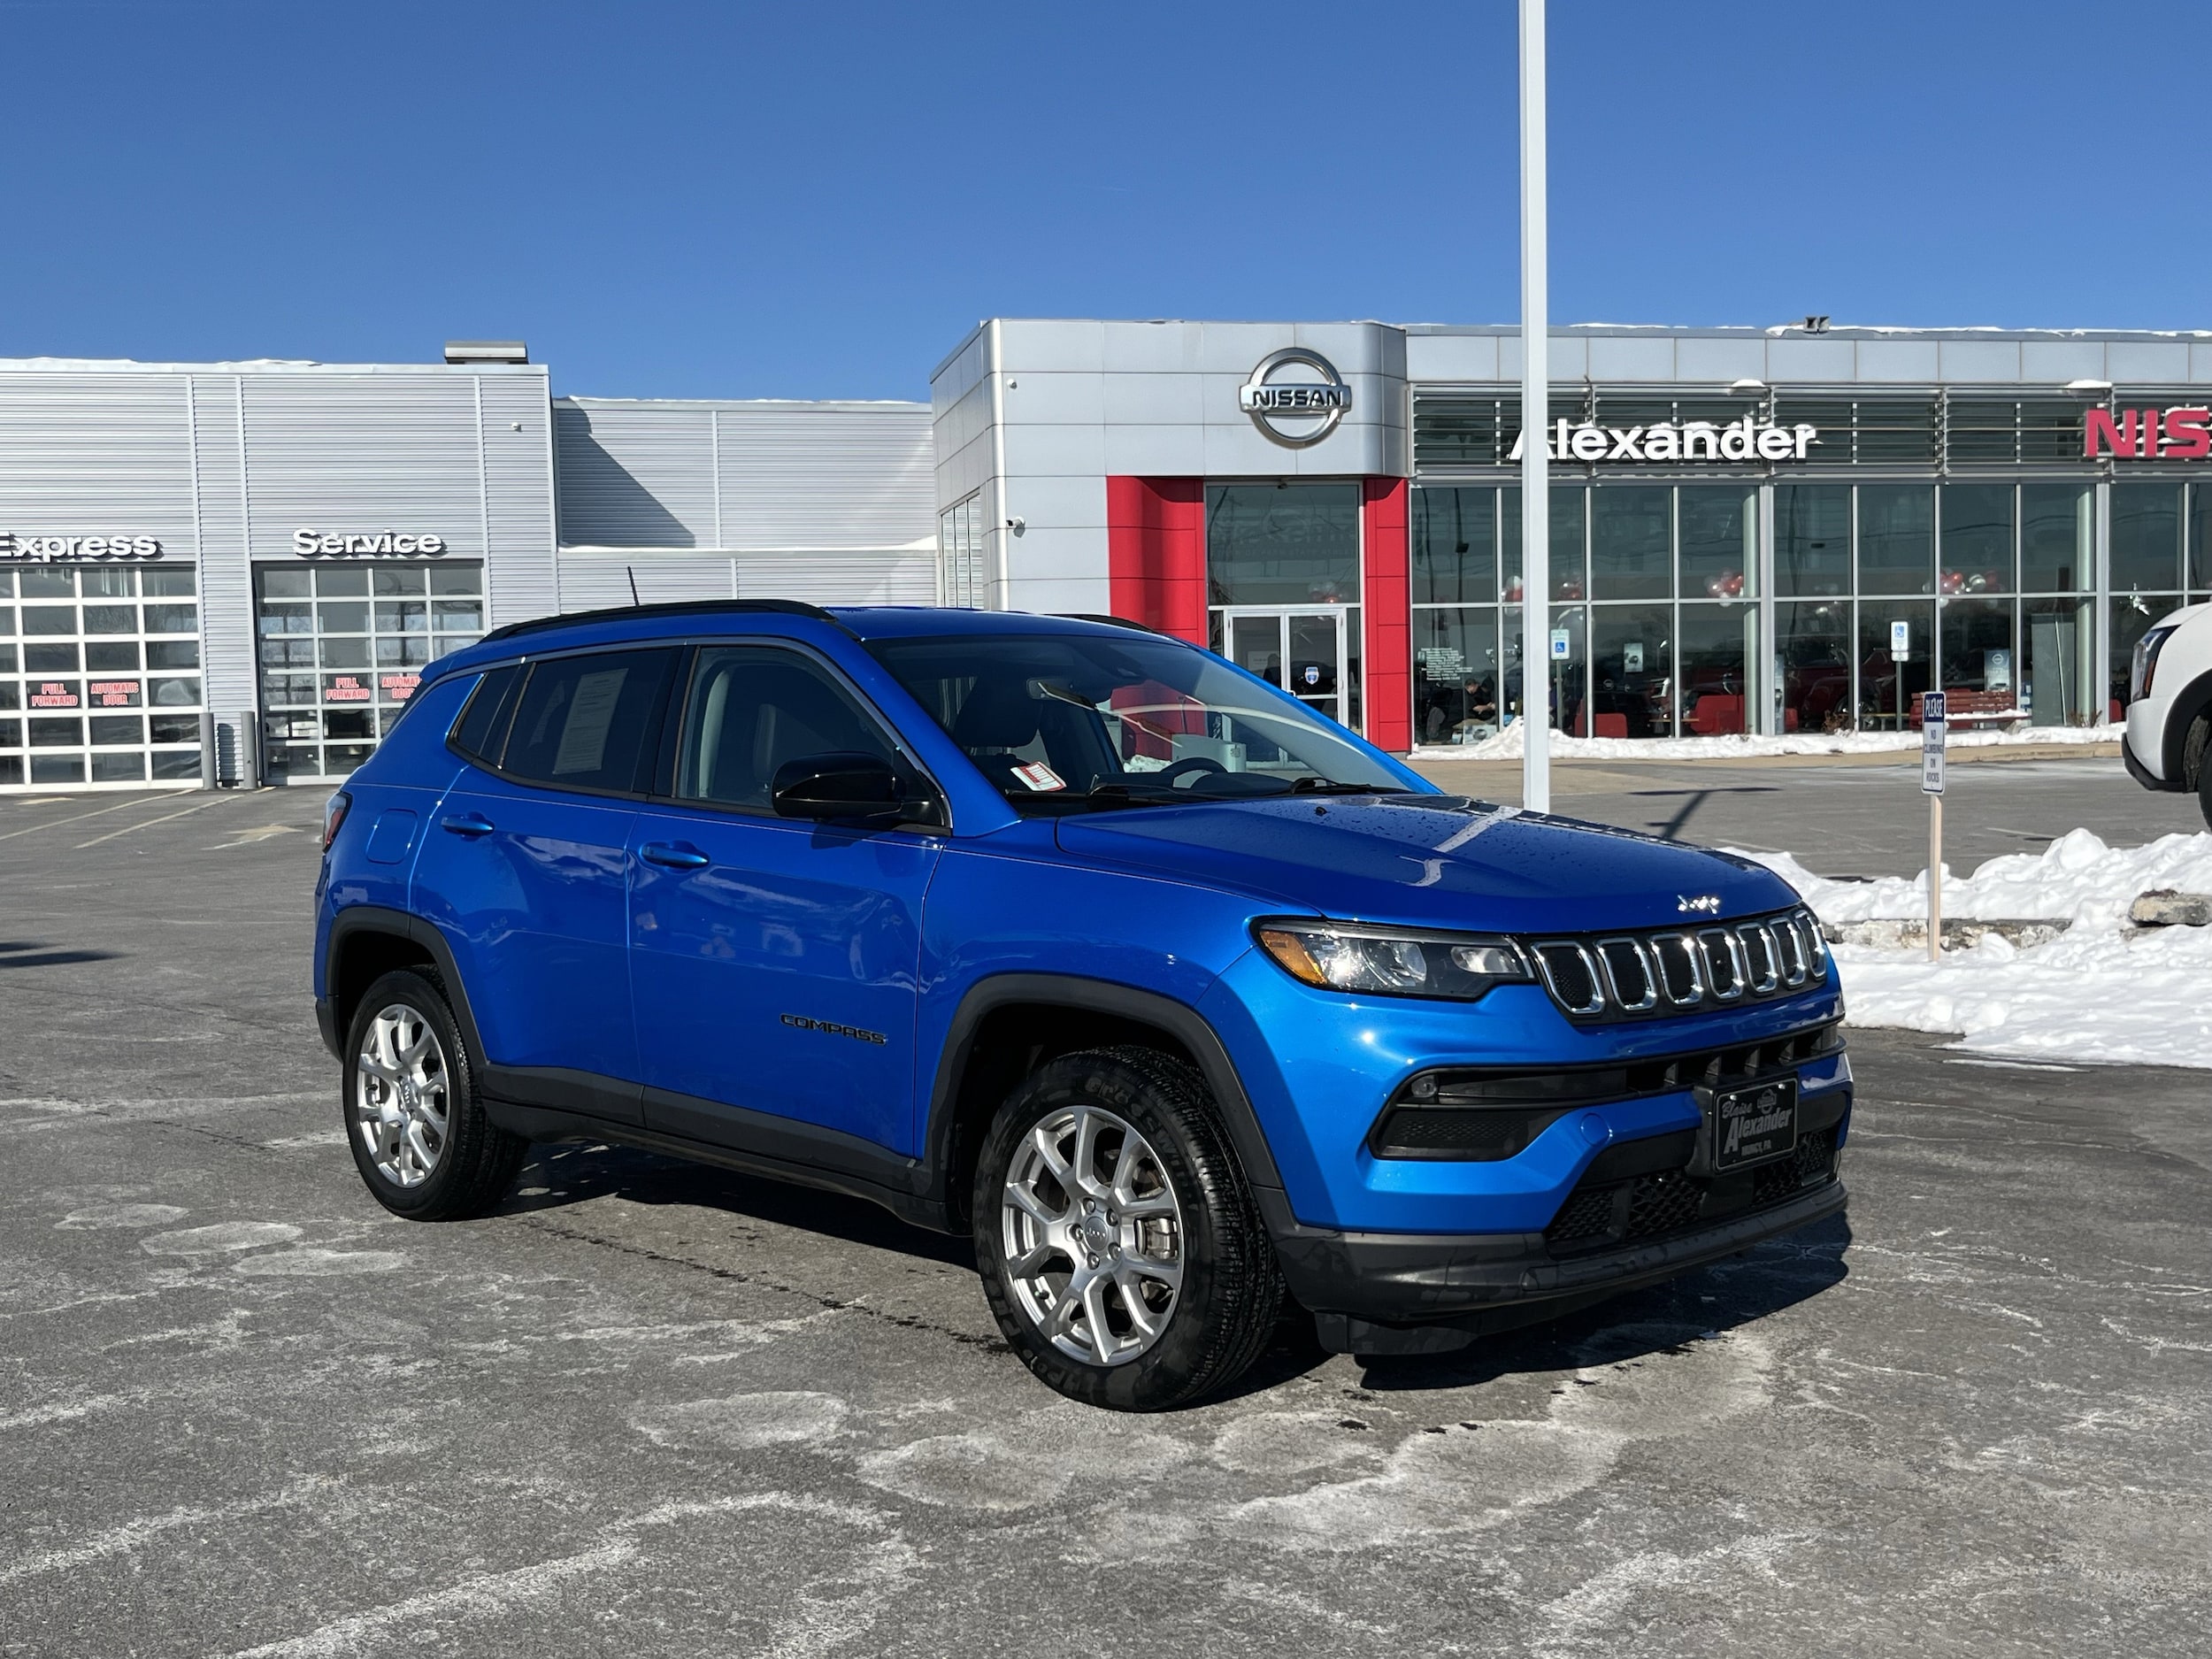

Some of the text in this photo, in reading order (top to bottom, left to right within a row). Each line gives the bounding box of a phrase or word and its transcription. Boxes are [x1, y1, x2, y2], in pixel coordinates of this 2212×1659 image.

[1253, 390, 1342, 406] NISSAN
[293, 528, 442, 555] Service
[42, 683, 66, 695] PULL
[91, 682, 139, 694] AUTOMATIC
[336, 678, 359, 688] PULL
[326, 688, 370, 700] FORWARD
[392, 688, 414, 698] DOO
[32, 695, 78, 706] FORWARD
[103, 695, 127, 705] DOOR
[1925, 698, 1943, 718] PLEASE
[1931, 729, 1936, 740] NO
[1930, 758, 1936, 768] ON
[1926, 772, 1939, 783] ROCKS
[780, 1013, 887, 1046] COMPASS
[1722, 1101, 1753, 1118] Blaise
[1724, 1108, 1793, 1154] Alexander
